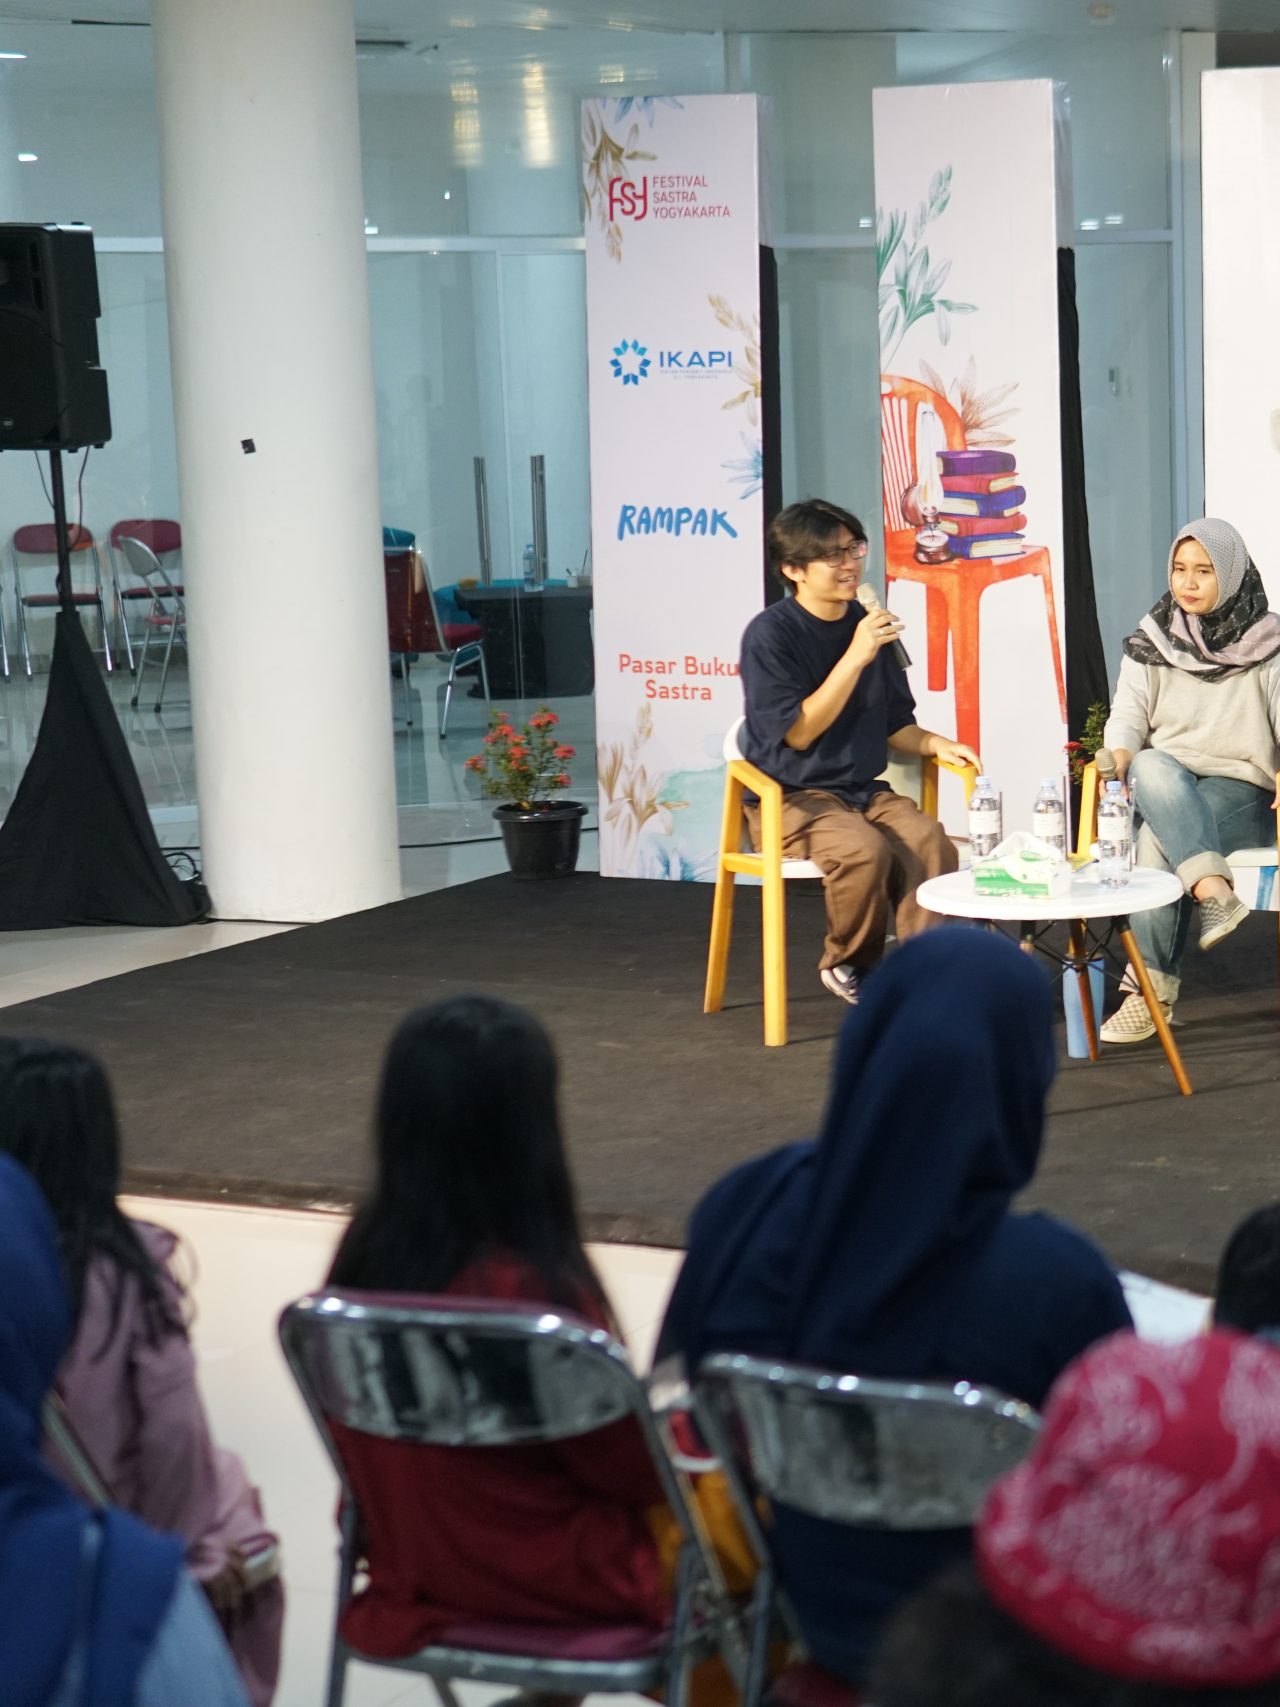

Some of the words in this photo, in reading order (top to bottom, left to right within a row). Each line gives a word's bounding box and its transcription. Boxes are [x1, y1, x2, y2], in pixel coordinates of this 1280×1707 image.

[652, 175, 709, 189] FESTIVAL
[653, 191, 698, 204] SASTRA
[653, 205, 732, 220] YOGYAKARTA
[660, 351, 733, 368] IKAPI
[616, 503, 738, 542] RAMPAK
[618, 653, 677, 675] Pasar
[684, 655, 740, 677] Buku
[645, 679, 712, 701] Sastra
